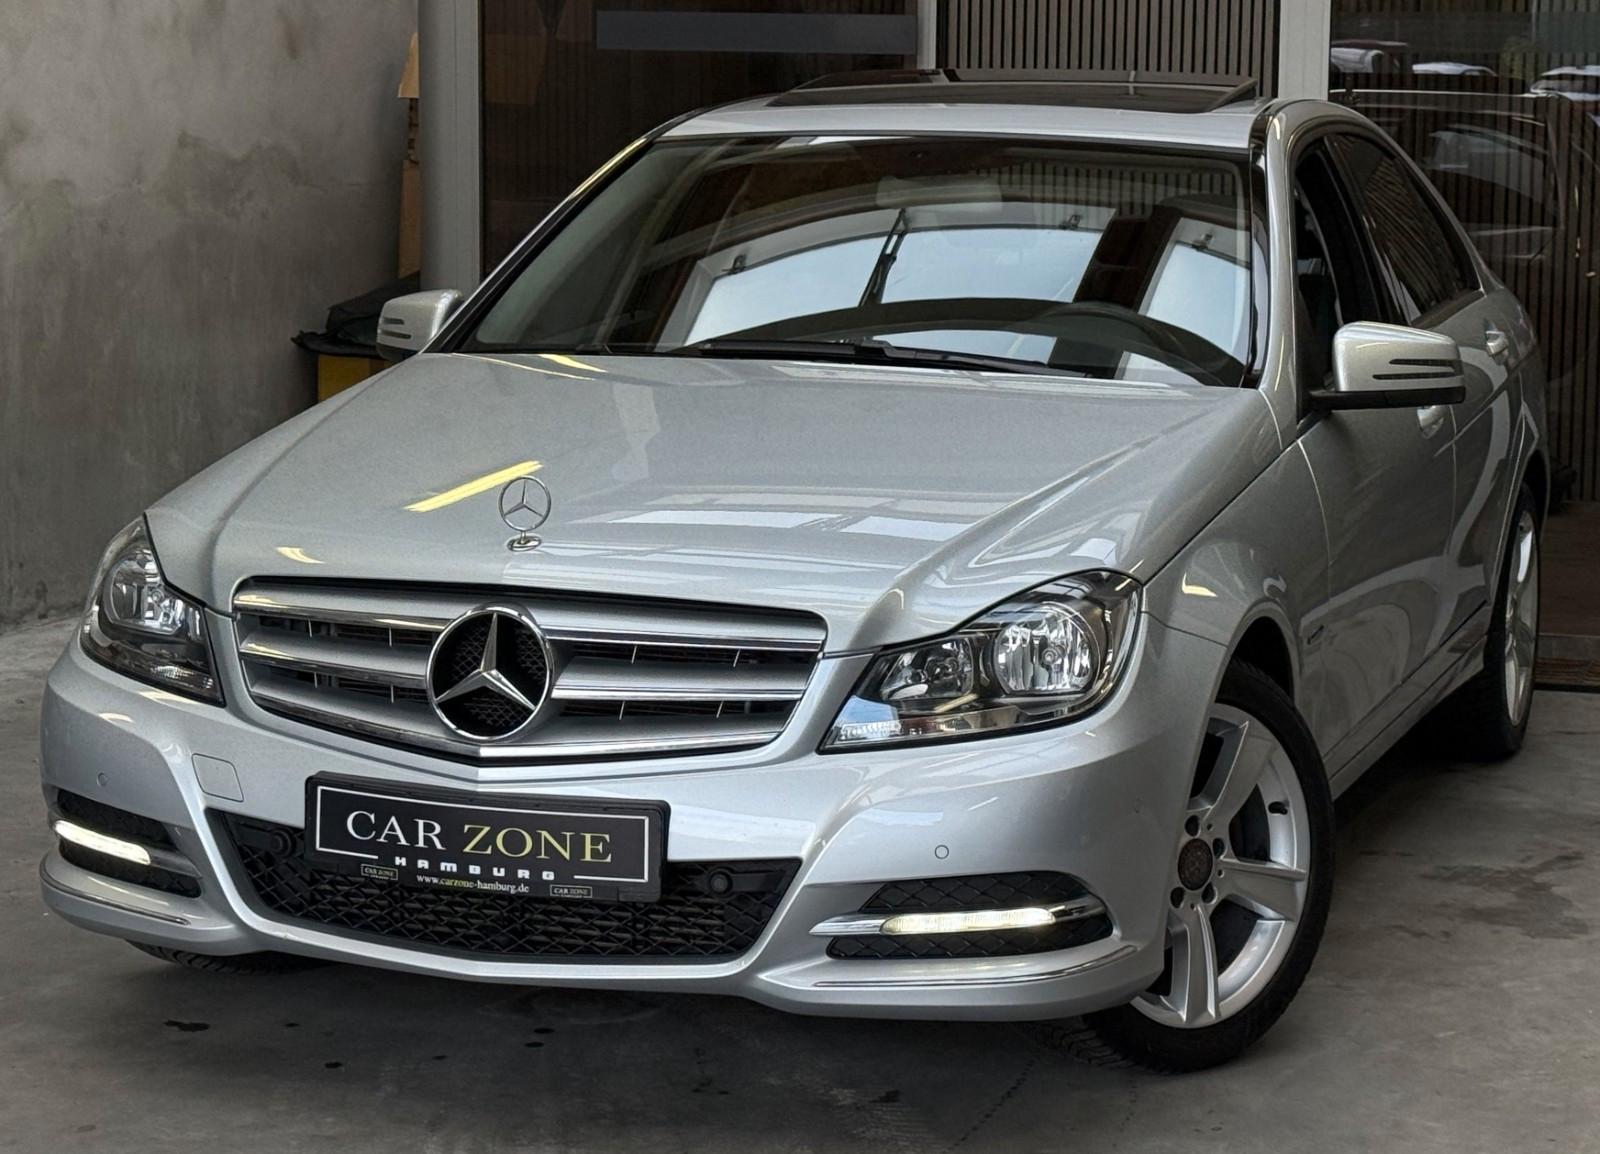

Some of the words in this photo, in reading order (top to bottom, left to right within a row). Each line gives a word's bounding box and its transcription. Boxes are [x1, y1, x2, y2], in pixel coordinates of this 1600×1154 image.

[347, 811, 447, 850] CAR
[463, 824, 612, 863] ZONE
[395, 856, 555, 881] HAMBURG
[416, 875, 530, 894] www.carzone-hamburg.de
